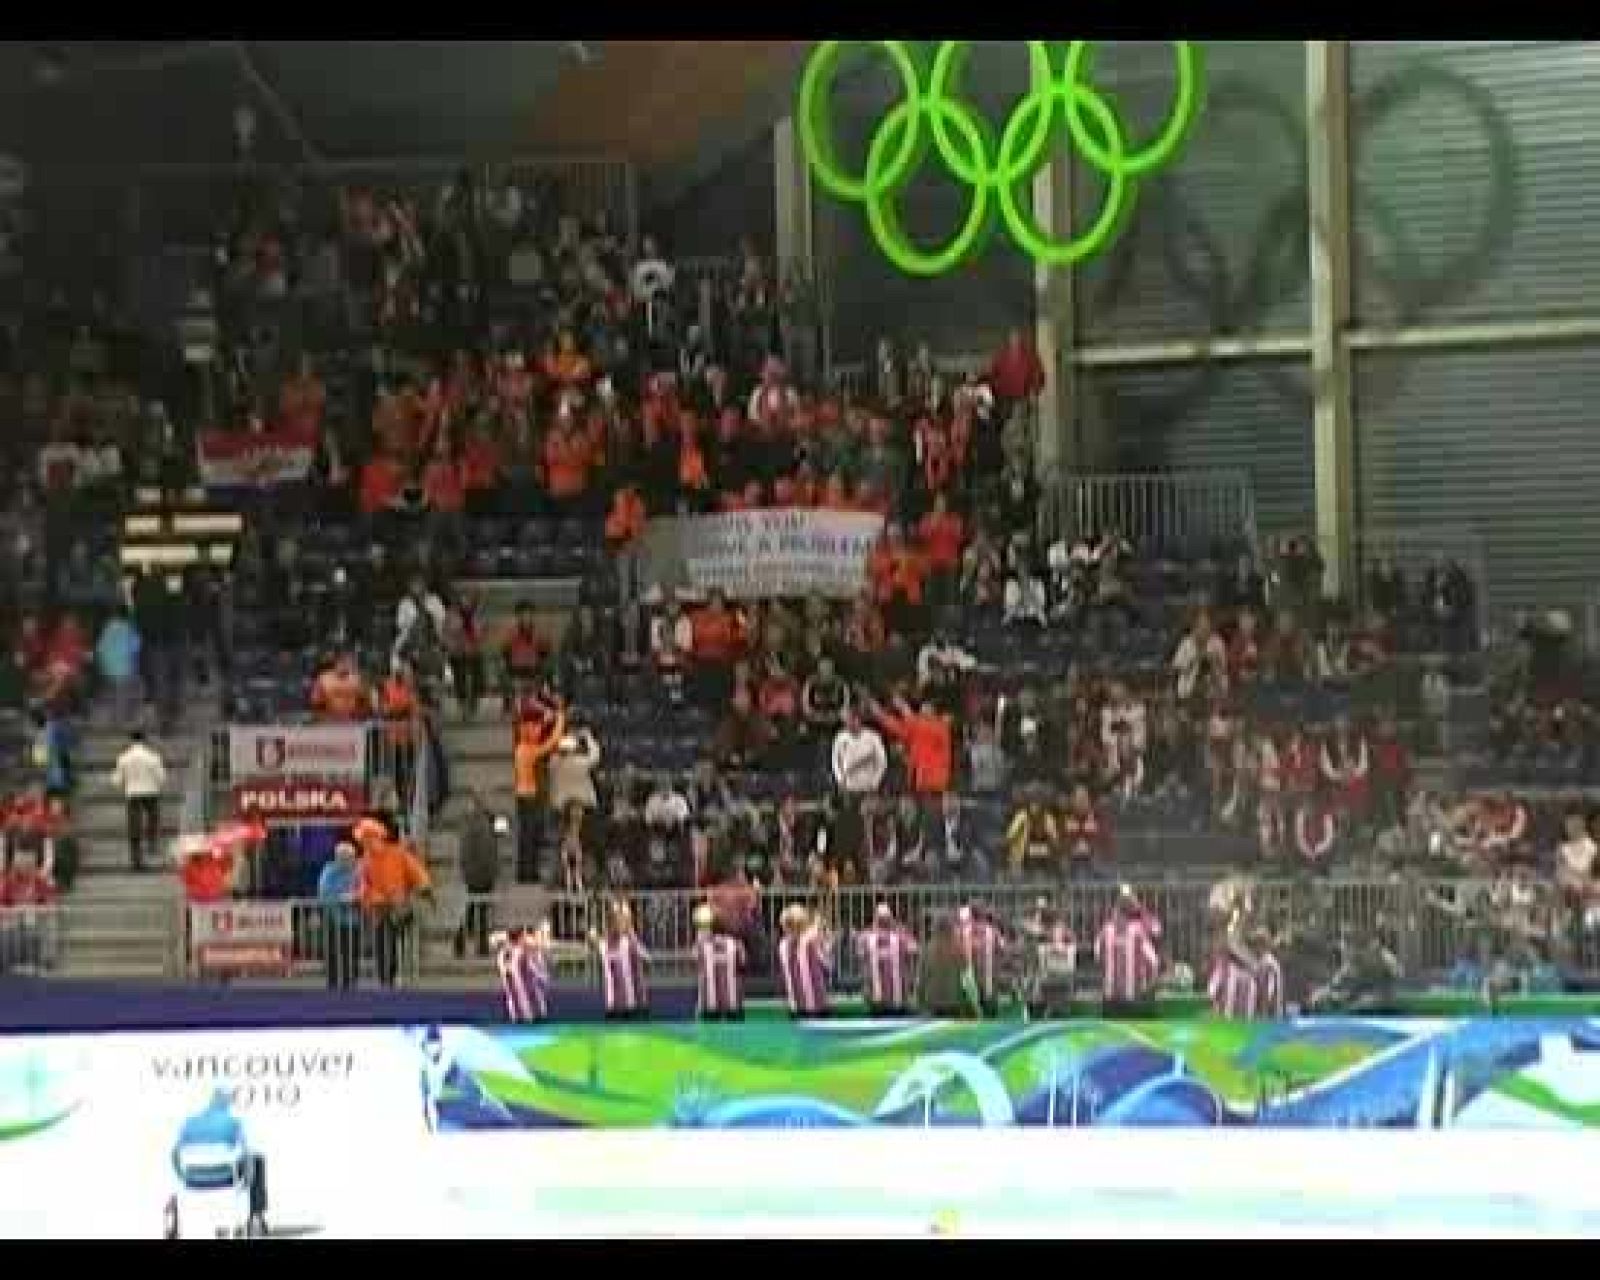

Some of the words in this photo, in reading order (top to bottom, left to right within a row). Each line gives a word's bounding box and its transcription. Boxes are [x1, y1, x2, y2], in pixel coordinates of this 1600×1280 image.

[241, 790, 347, 810] POLSKA
[151, 1051, 355, 1079] vancouver
[222, 1083, 302, 1107] 010
